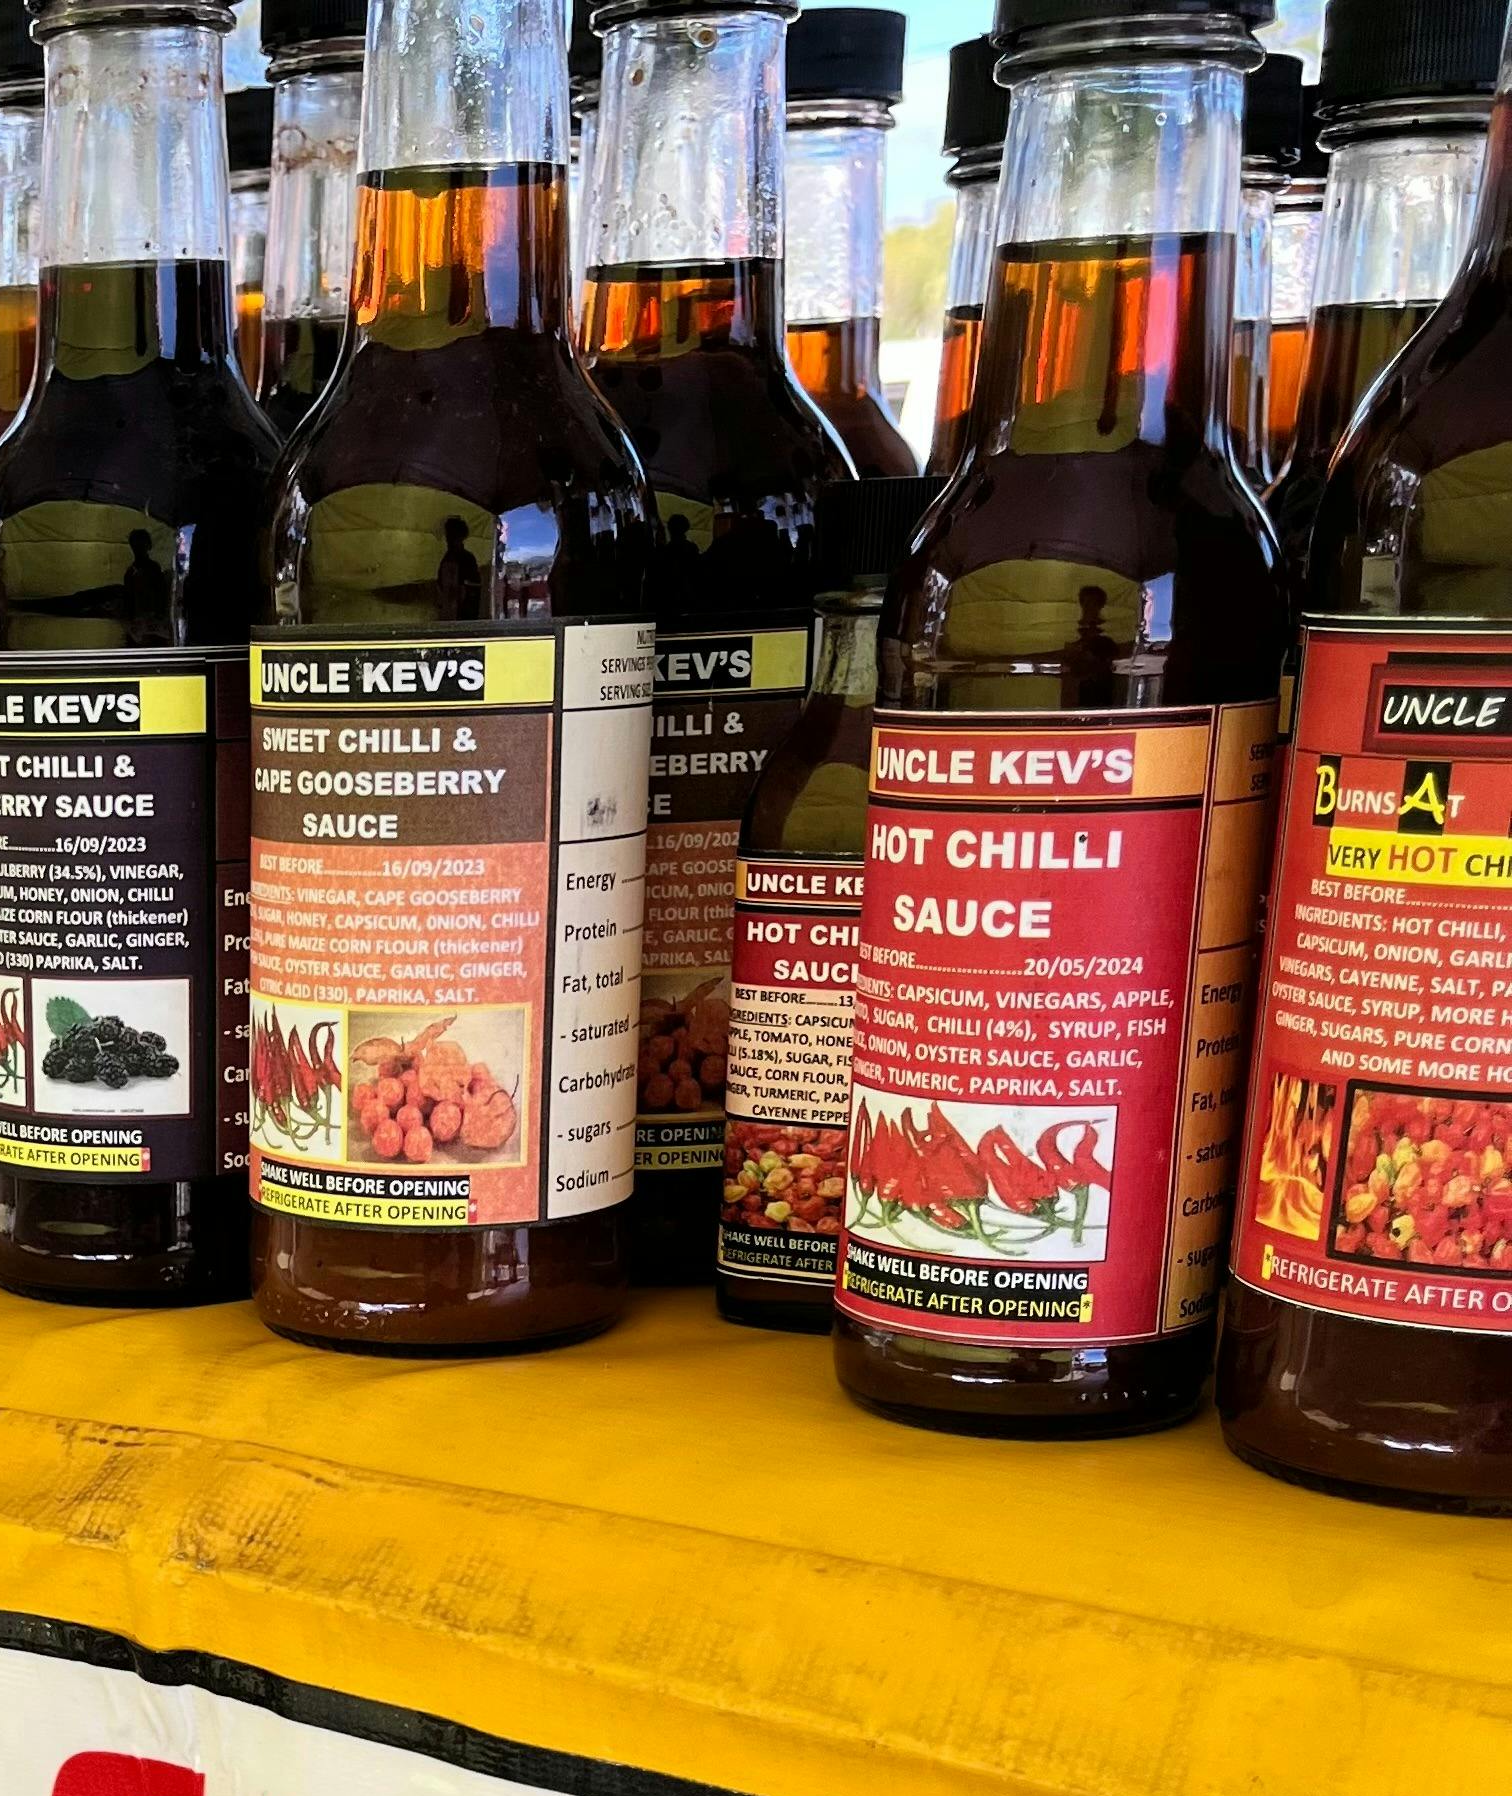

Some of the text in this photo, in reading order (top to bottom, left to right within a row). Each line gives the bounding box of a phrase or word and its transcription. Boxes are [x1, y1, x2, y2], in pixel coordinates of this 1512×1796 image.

[262, 659, 484, 694] UNCLE KEV'S
[34, 694, 140, 723] KEV'S
[1383, 694, 1506, 727] UNCLE
[263, 727, 477, 753] SWEET CHILLI &
[16, 755, 102, 778] CHILLI
[113, 755, 135, 777] &
[877, 746, 1133, 785] UNCLE KEV'S
[255, 768, 506, 796] CAPE GOOSEBERRY
[55, 794, 154, 817] SAUCE
[303, 813, 398, 839] SAUCE
[872, 824, 1123, 870] HOT CHILLI
[1328, 844, 1458, 873] VERY HOT
[49, 864, 183, 882] (34.5%), VINEGAR,
[567, 872, 616, 891] Energy
[746, 873, 827, 896] UNCLE
[127, 887, 173, 901] CHILLI
[365, 888, 521, 906] CAPE GOOSEBERRY
[1311, 879, 1341, 899] BEST
[18, 907, 189, 927] CORN FLOUR (thickener)
[893, 895, 1052, 939] SAUCE
[1392, 916, 1506, 942] HOT CHILLI,
[565, 920, 617, 942] Protein
[746, 922, 801, 944] HOT
[1297, 932, 1443, 968] CAPSICUM, ONION,
[36, 956, 98, 972] PAPRIKA,
[1339, 967, 1485, 999] CAYENNE, SALT,
[897, 984, 1174, 1012] CAPSICUM, VINEGARS, APPLE,
[1361, 998, 1426, 1025] SYRUP,
[927, 1015, 1167, 1042] CHILLI (4%), FISH
[1321, 1020, 1444, 1051] SUGARS, PURE
[915, 1043, 1143, 1069] OYSTER GARLIC,
[1359, 1054, 1479, 1082] SOME MORE
[970, 1076, 1063, 1099] PAPRIKA,
[752, 1105, 807, 1120] CAYENNE
[20, 1124, 142, 1145] BEFORE OPENING
[567, 1118, 611, 1143] sugars
[27, 1147, 140, 1167] AFTER OPENING
[327, 1174, 470, 1198] BEFORE OPENING
[556, 1168, 610, 1192] Sodium
[334, 1201, 467, 1221] AFTER OPENING
[879, 1254, 1088, 1290] WELL BEFORE OPENING
[927, 1291, 1080, 1319] AFTER OPENING
[1405, 1287, 1483, 1312] AFTER
